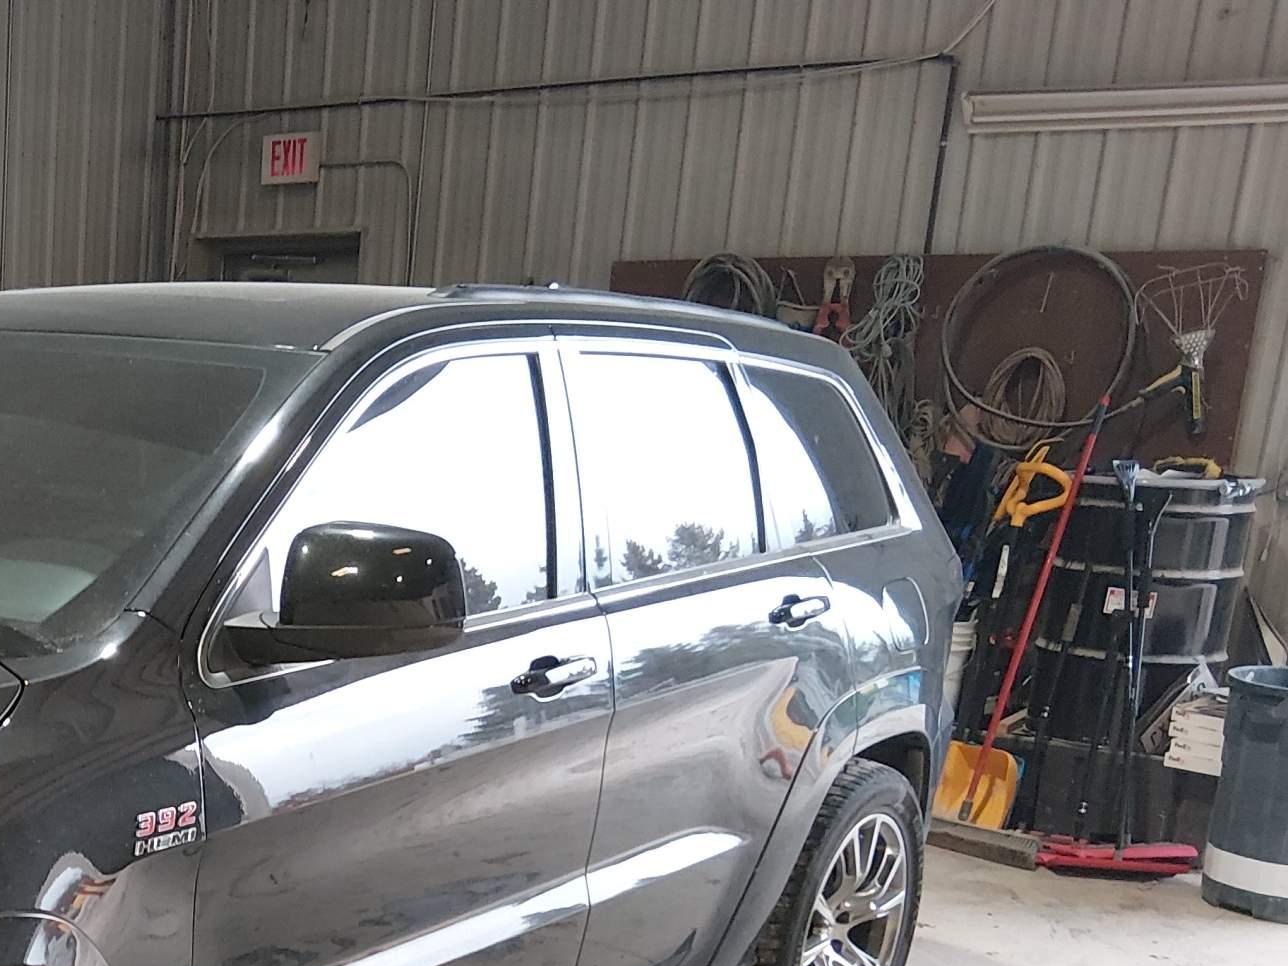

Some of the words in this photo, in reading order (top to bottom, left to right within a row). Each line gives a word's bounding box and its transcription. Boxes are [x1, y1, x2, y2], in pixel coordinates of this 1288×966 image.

[271, 138, 307, 176] EXIT
[135, 801, 197, 838] 392
[134, 827, 197, 857] HEMI
